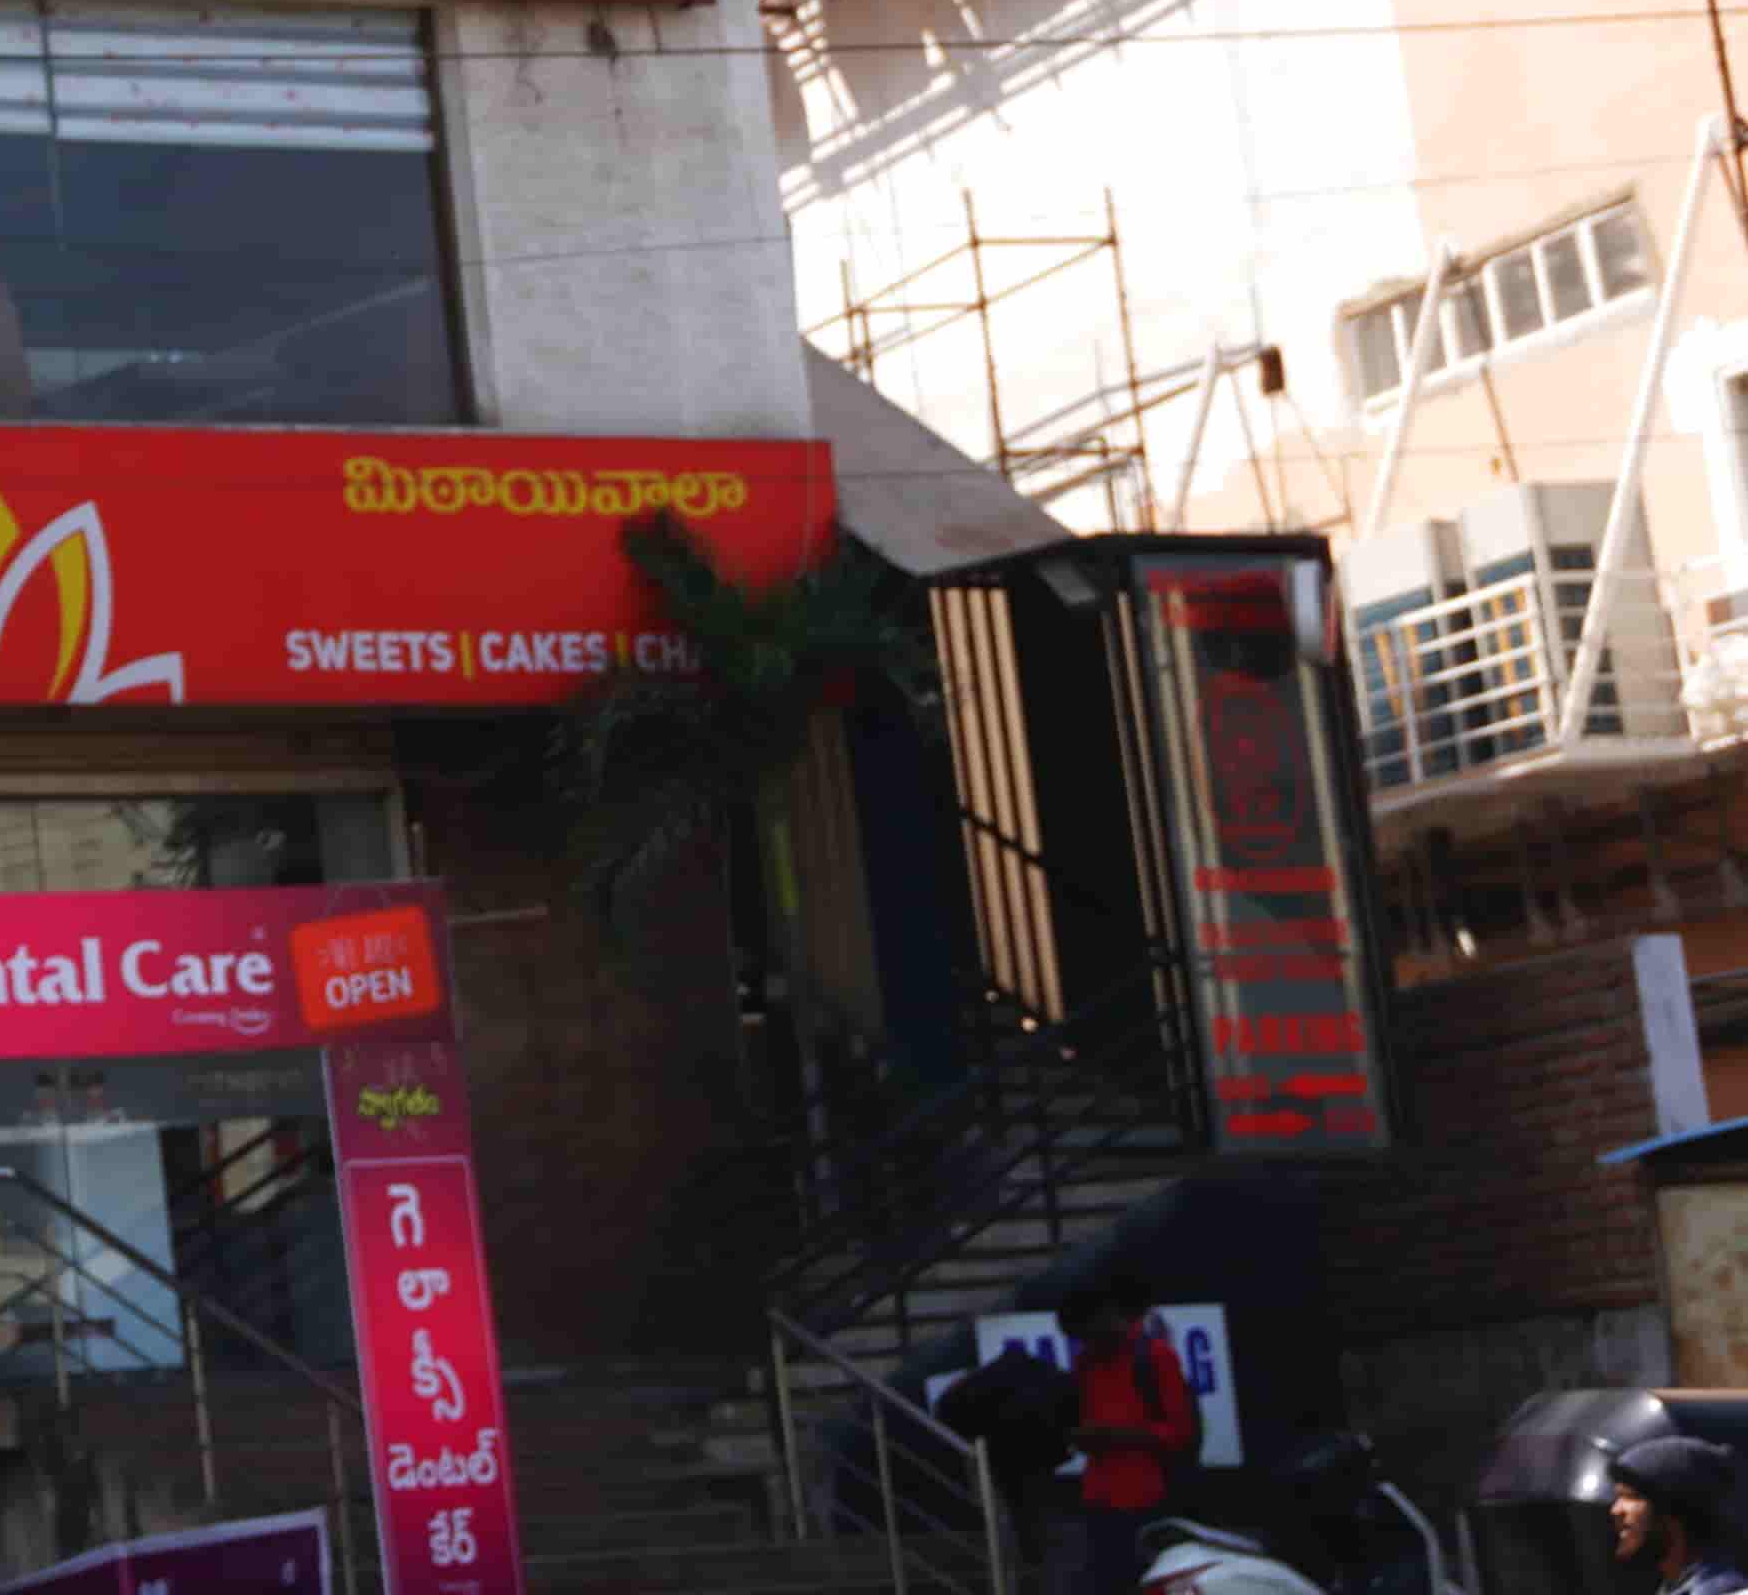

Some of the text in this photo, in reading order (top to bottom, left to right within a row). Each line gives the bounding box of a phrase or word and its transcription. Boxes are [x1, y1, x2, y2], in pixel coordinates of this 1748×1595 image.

[284, 629, 455, 673] SWEETS
[478, 630, 607, 675] CAKES
[120, 939, 274, 999] Care
[325, 966, 413, 1010] OPEN
[1212, 1011, 1367, 1058] PARKING
